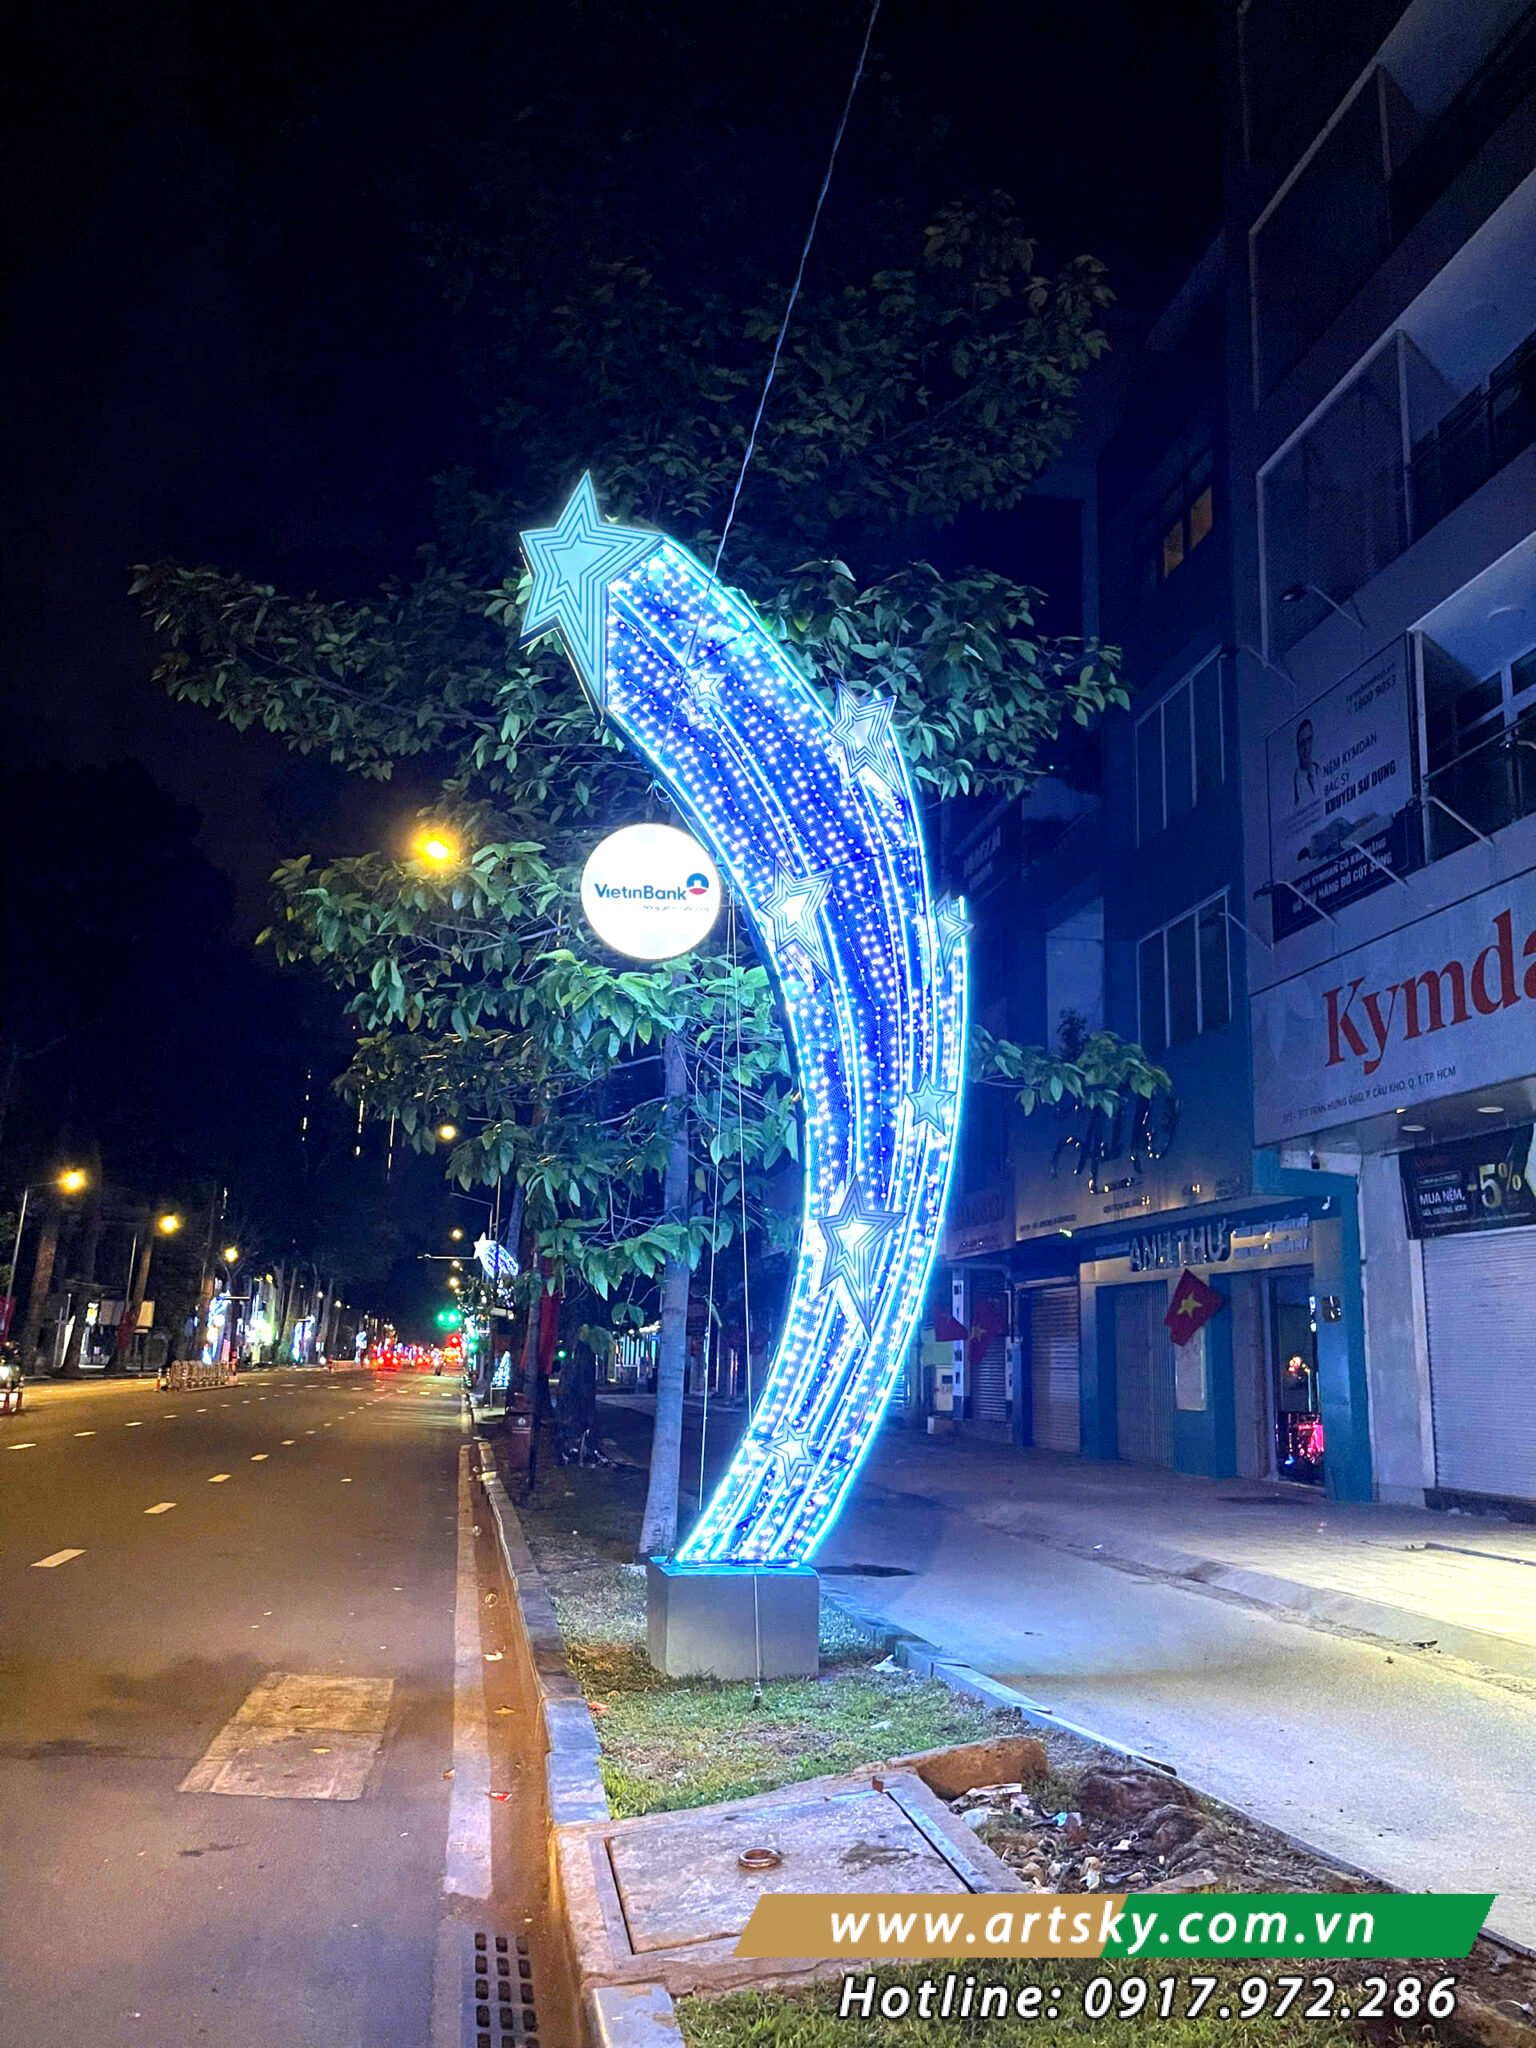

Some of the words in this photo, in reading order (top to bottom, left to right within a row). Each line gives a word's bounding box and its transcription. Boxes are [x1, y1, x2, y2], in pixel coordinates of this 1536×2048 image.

[1342, 731, 1377, 764] KYMDAN
[1371, 759, 1397, 787] DỤNG
[594, 883, 687, 900] VietinBank
[1436, 1064, 1457, 1081] HCM
[1419, 1190, 1442, 1206] MUA
[1130, 1230, 1173, 1272] ANH
[1176, 1217, 1229, 1266] THƯ
